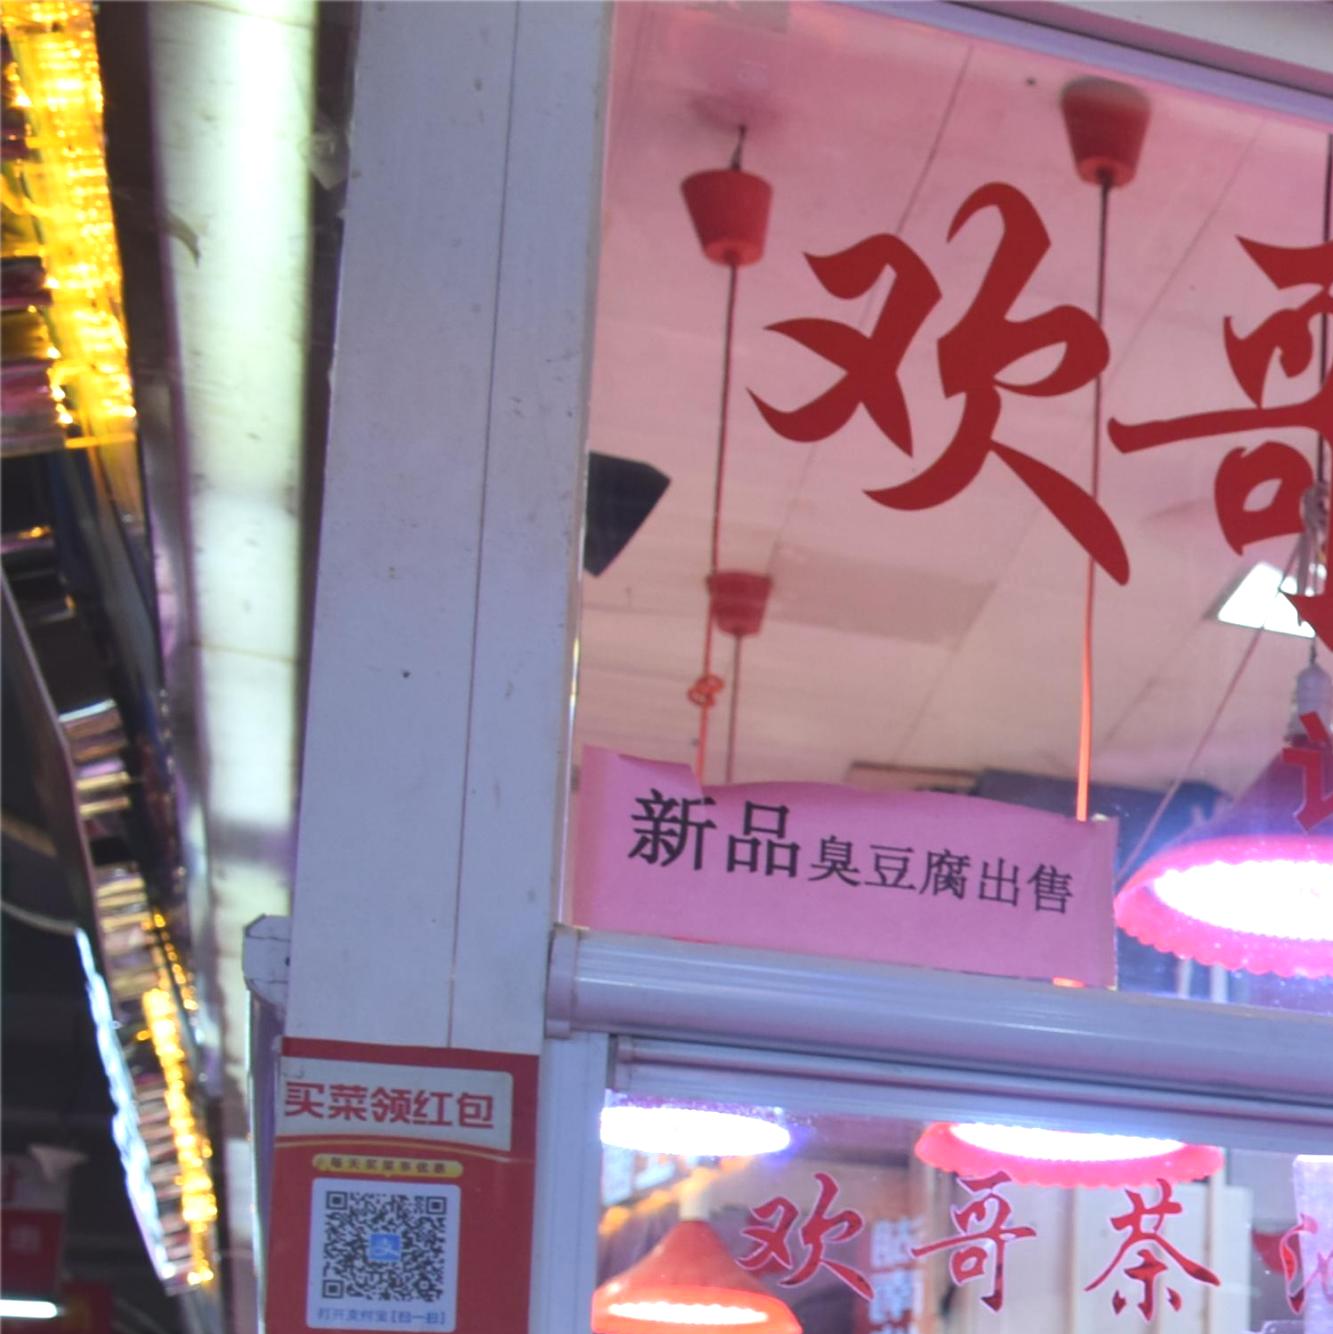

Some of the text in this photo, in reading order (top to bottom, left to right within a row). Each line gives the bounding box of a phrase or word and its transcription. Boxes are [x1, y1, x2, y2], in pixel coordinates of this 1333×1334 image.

[628, 788, 1075, 914] 新品臭豆腐出售
[284, 1081, 495, 1129] 买菜领红包
